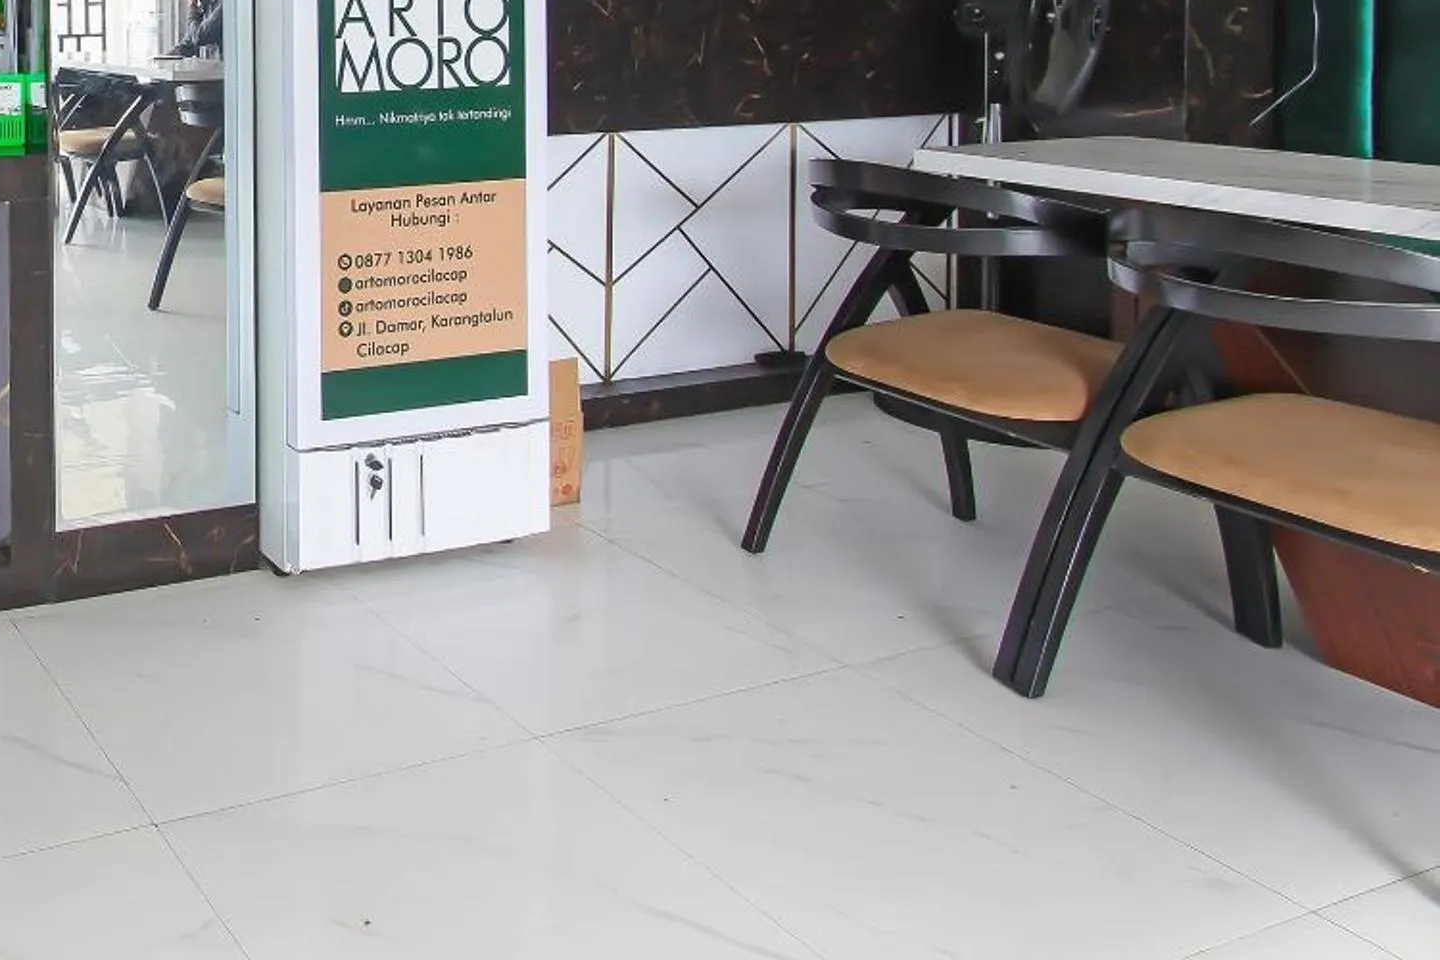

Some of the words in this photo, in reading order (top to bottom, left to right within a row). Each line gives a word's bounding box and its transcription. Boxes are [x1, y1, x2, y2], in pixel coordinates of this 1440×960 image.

[338, 36, 510, 91] MORO
[351, 197, 411, 215] Layanan
[416, 193, 456, 208] Pesan
[460, 191, 497, 205] Antar
[390, 210, 451, 227] Hubungi
[355, 251, 392, 268] 0877
[398, 248, 434, 264] 1304
[439, 244, 474, 260] 1986
[355, 269, 468, 289] artomorocilacap
[355, 291, 468, 313] artomorocilacap
[375, 319, 427, 334] Damar,
[431, 308, 514, 328] Karangtalun
[357, 340, 410, 358] Cilacap
